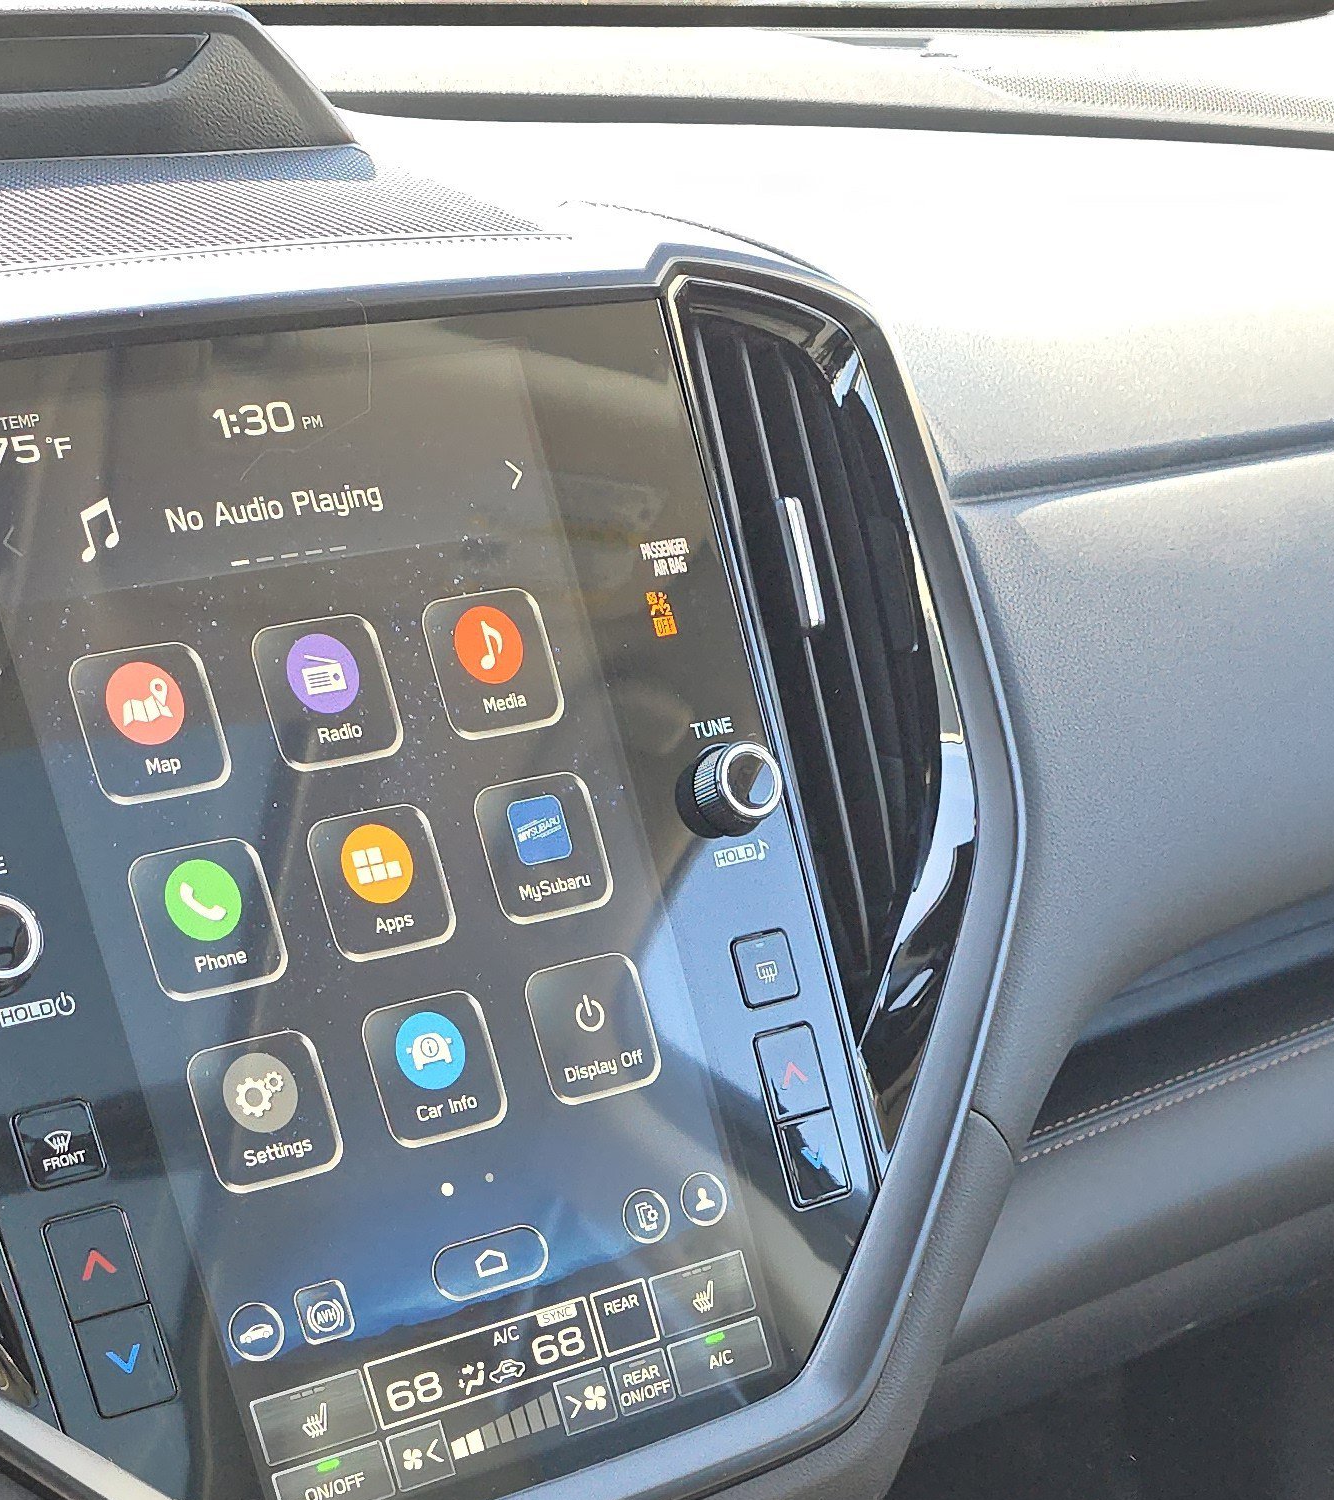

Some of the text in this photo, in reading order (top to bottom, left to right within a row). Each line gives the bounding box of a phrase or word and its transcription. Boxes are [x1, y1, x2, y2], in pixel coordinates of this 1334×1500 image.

[212, 401, 324, 439] 1:30 PM
[164, 484, 384, 533] No Audio Playing
[639, 537, 690, 561] PASSENGER
[482, 692, 528, 714] Media
[316, 722, 363, 744] Radio
[689, 716, 735, 739] TUNE
[144, 757, 182, 776] Map
[714, 845, 756, 866] HOLD
[518, 874, 592, 902] MySubaru
[375, 914, 415, 935] Apps
[194, 950, 248, 973] Phone
[563, 1048, 643, 1083] Display Off
[415, 1094, 478, 1122] Car Info
[42, 1149, 86, 1172] FRONT
[243, 1138, 313, 1167] Settings
[316, 1307, 337, 1325] AVH
[541, 1305, 574, 1324] SYNC
[603, 1293, 640, 1317] REAR
[492, 1325, 520, 1347] A/C
[531, 1325, 587, 1368] 68
[709, 1349, 734, 1370] A/C
[622, 1363, 661, 1388] REAR
[385, 1371, 444, 1413] 68
[619, 1378, 672, 1408] ON/OFF
